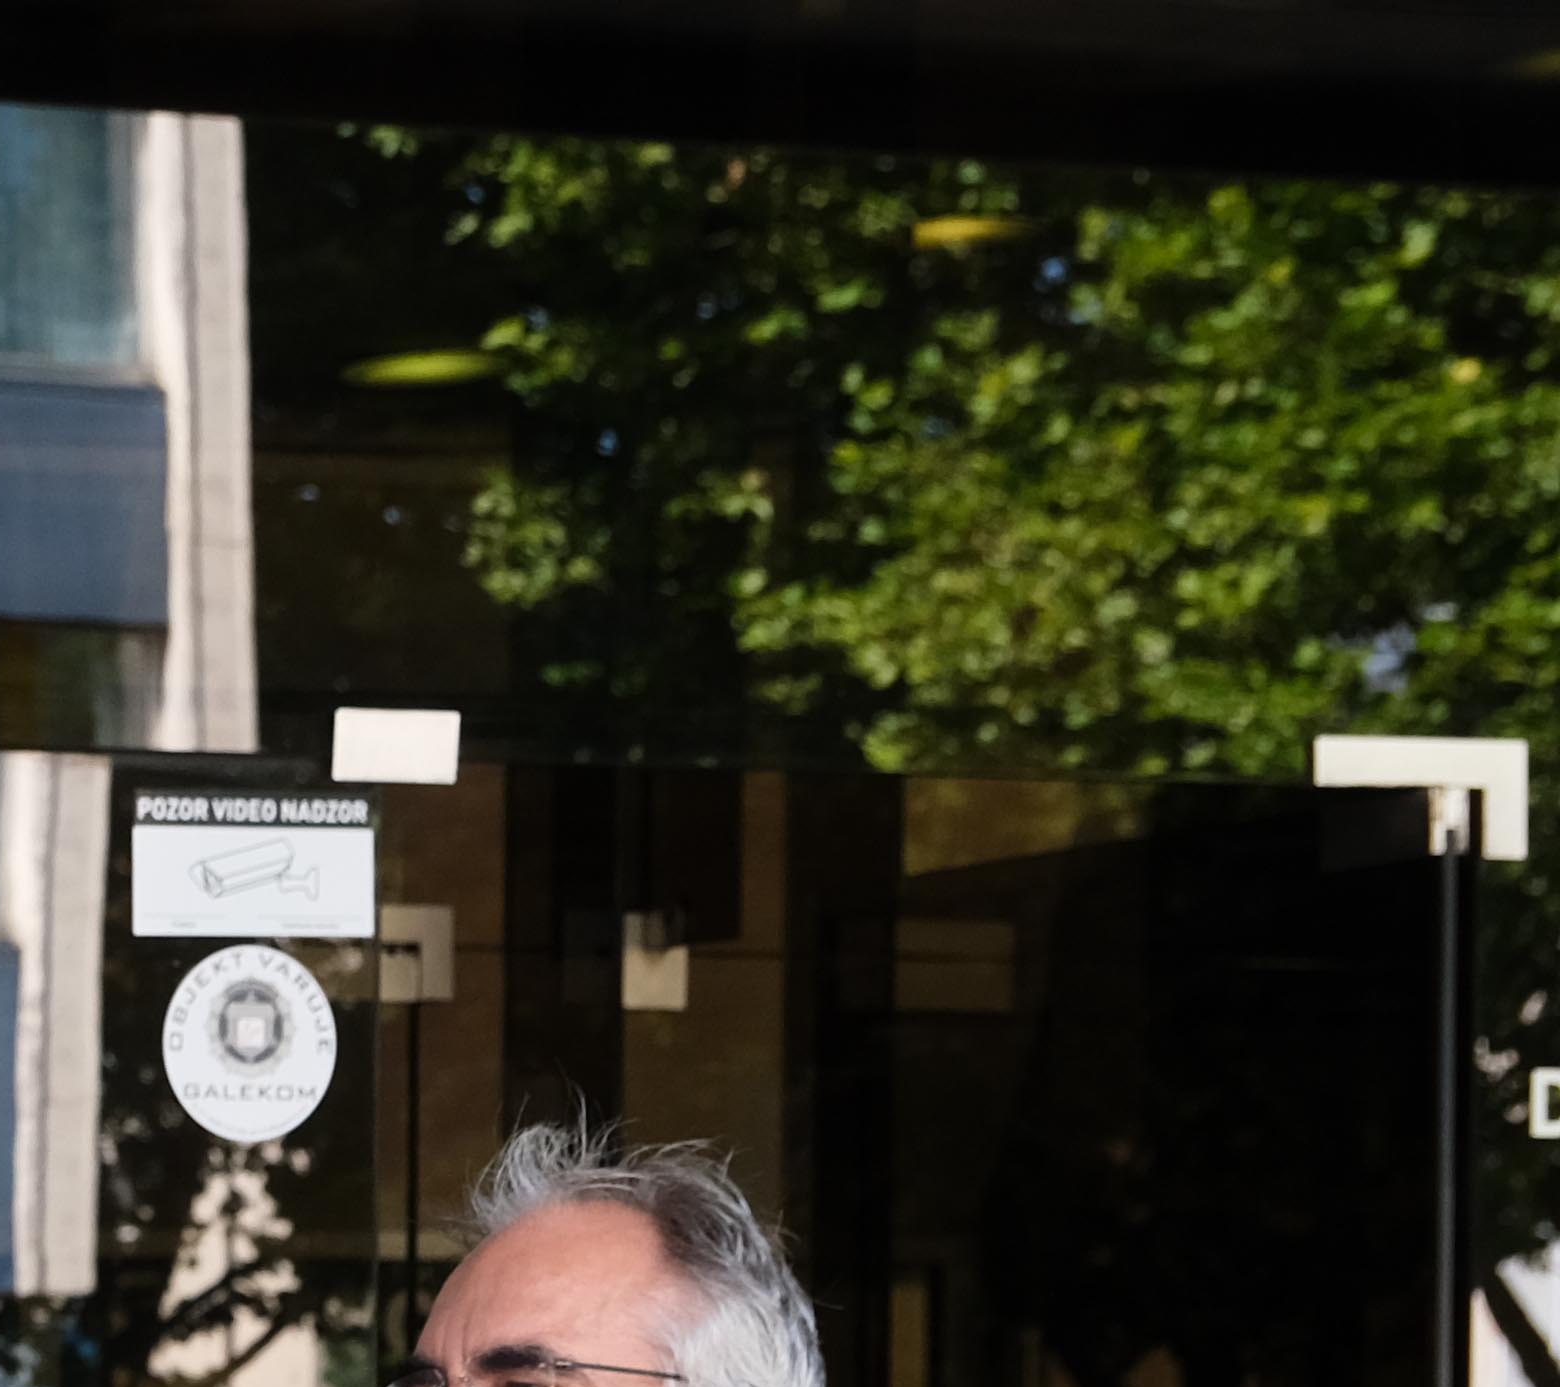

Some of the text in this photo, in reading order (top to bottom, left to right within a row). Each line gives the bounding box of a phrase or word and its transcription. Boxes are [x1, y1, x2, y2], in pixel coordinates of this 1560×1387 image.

[136, 796, 368, 824] POZOR VIDEO NADZOR
